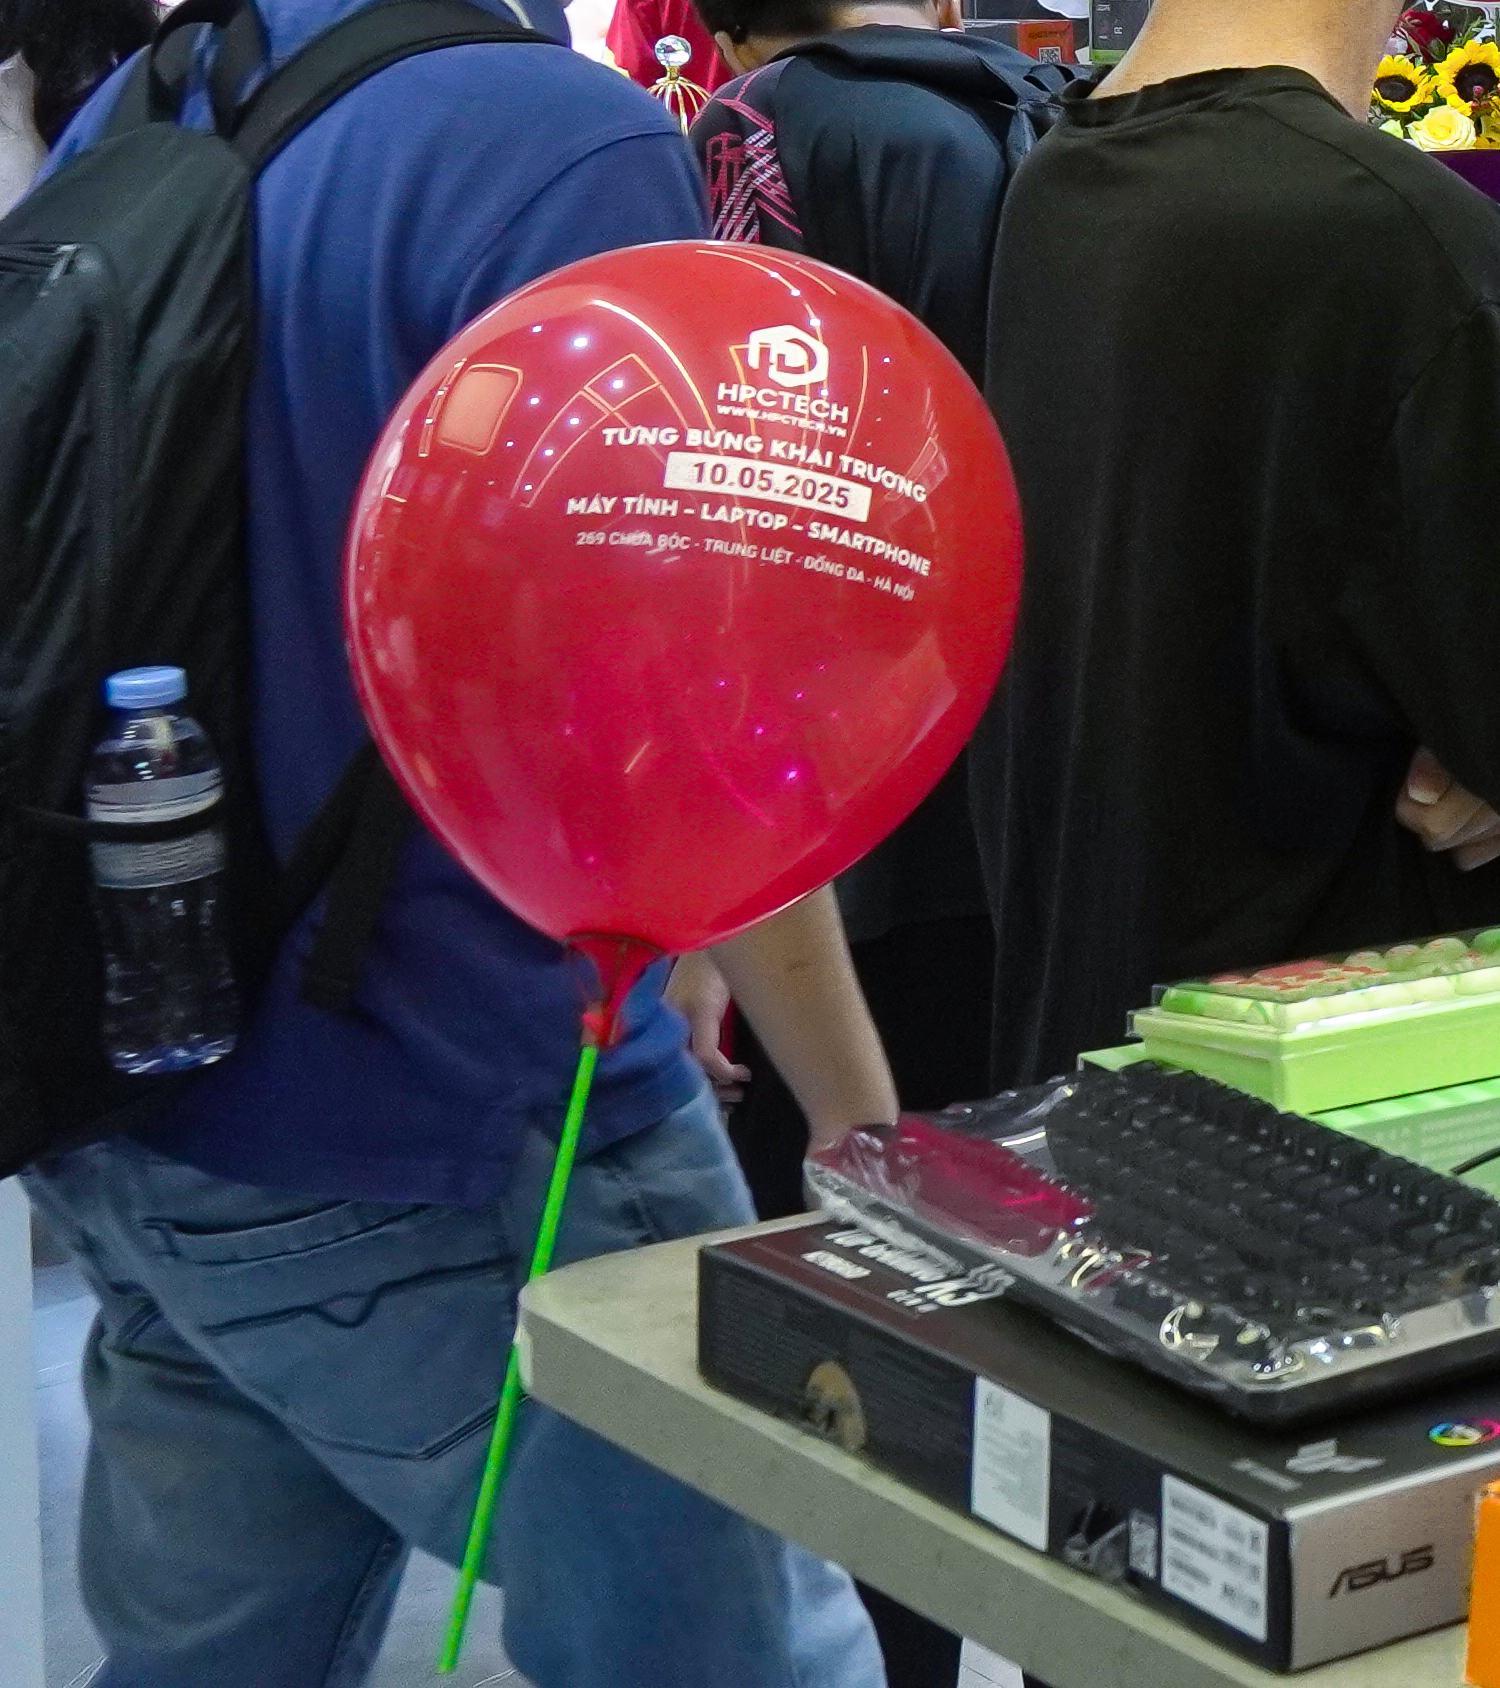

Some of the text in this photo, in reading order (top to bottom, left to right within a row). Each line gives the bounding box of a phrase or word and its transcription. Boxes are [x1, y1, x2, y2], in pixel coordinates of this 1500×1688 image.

[717, 382, 849, 424] HPCTECH
[693, 460, 850, 509] 10.05.2025
[770, 439, 833, 470] KHAI
[838, 453, 927, 502] TRƯƠNG
[566, 494, 931, 577] MÁY TÍNH LAPTOP SMARTPHONE
[704, 537, 757, 558] TRUNG
[1328, 1544, 1435, 1599] ASUS
